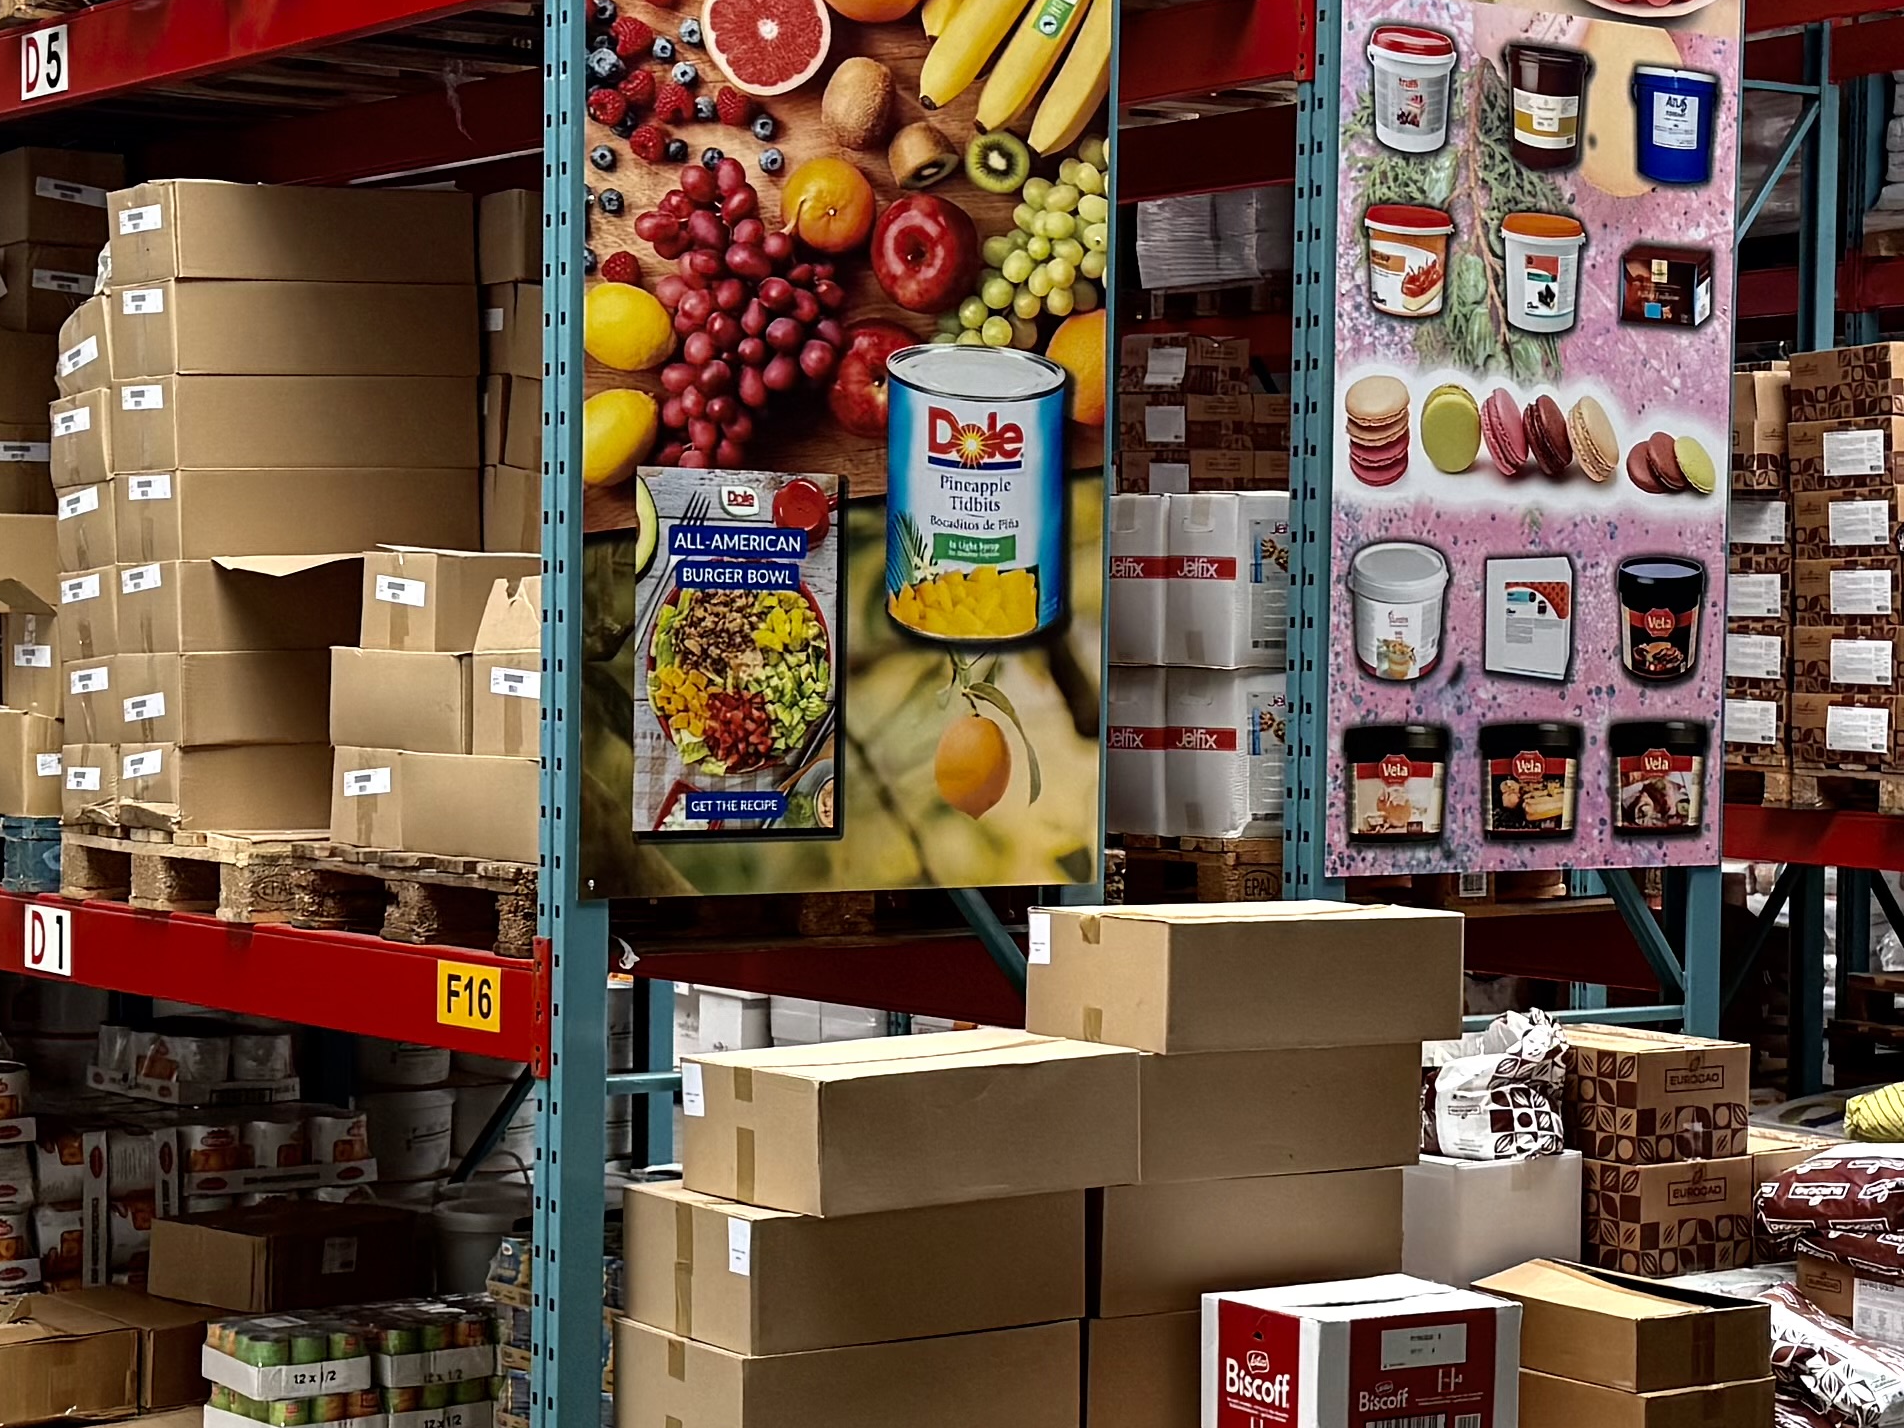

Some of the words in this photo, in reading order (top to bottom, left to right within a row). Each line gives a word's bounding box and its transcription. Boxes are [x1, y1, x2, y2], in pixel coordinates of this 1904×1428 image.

[928, 406, 1024, 467] Dole
[940, 474, 1011, 496] Pineapple
[949, 495, 1001, 512] Tidbits
[673, 532, 802, 552] ALL-AMERICAN
[682, 566, 744, 584] BURGER
[747, 567, 793, 585] BOWL
[1177, 559, 1218, 579] Jelfix
[1176, 730, 1217, 750] Jelfix
[691, 800, 715, 812] GET
[716, 800, 738, 812] THE
[739, 799, 778, 811] RECIPE
[446, 972, 492, 1020] F16
[1669, 1072, 1720, 1086] EUROCAO
[1226, 1357, 1290, 1408] Biscoff
[1359, 1387, 1409, 1412] Biscoff
